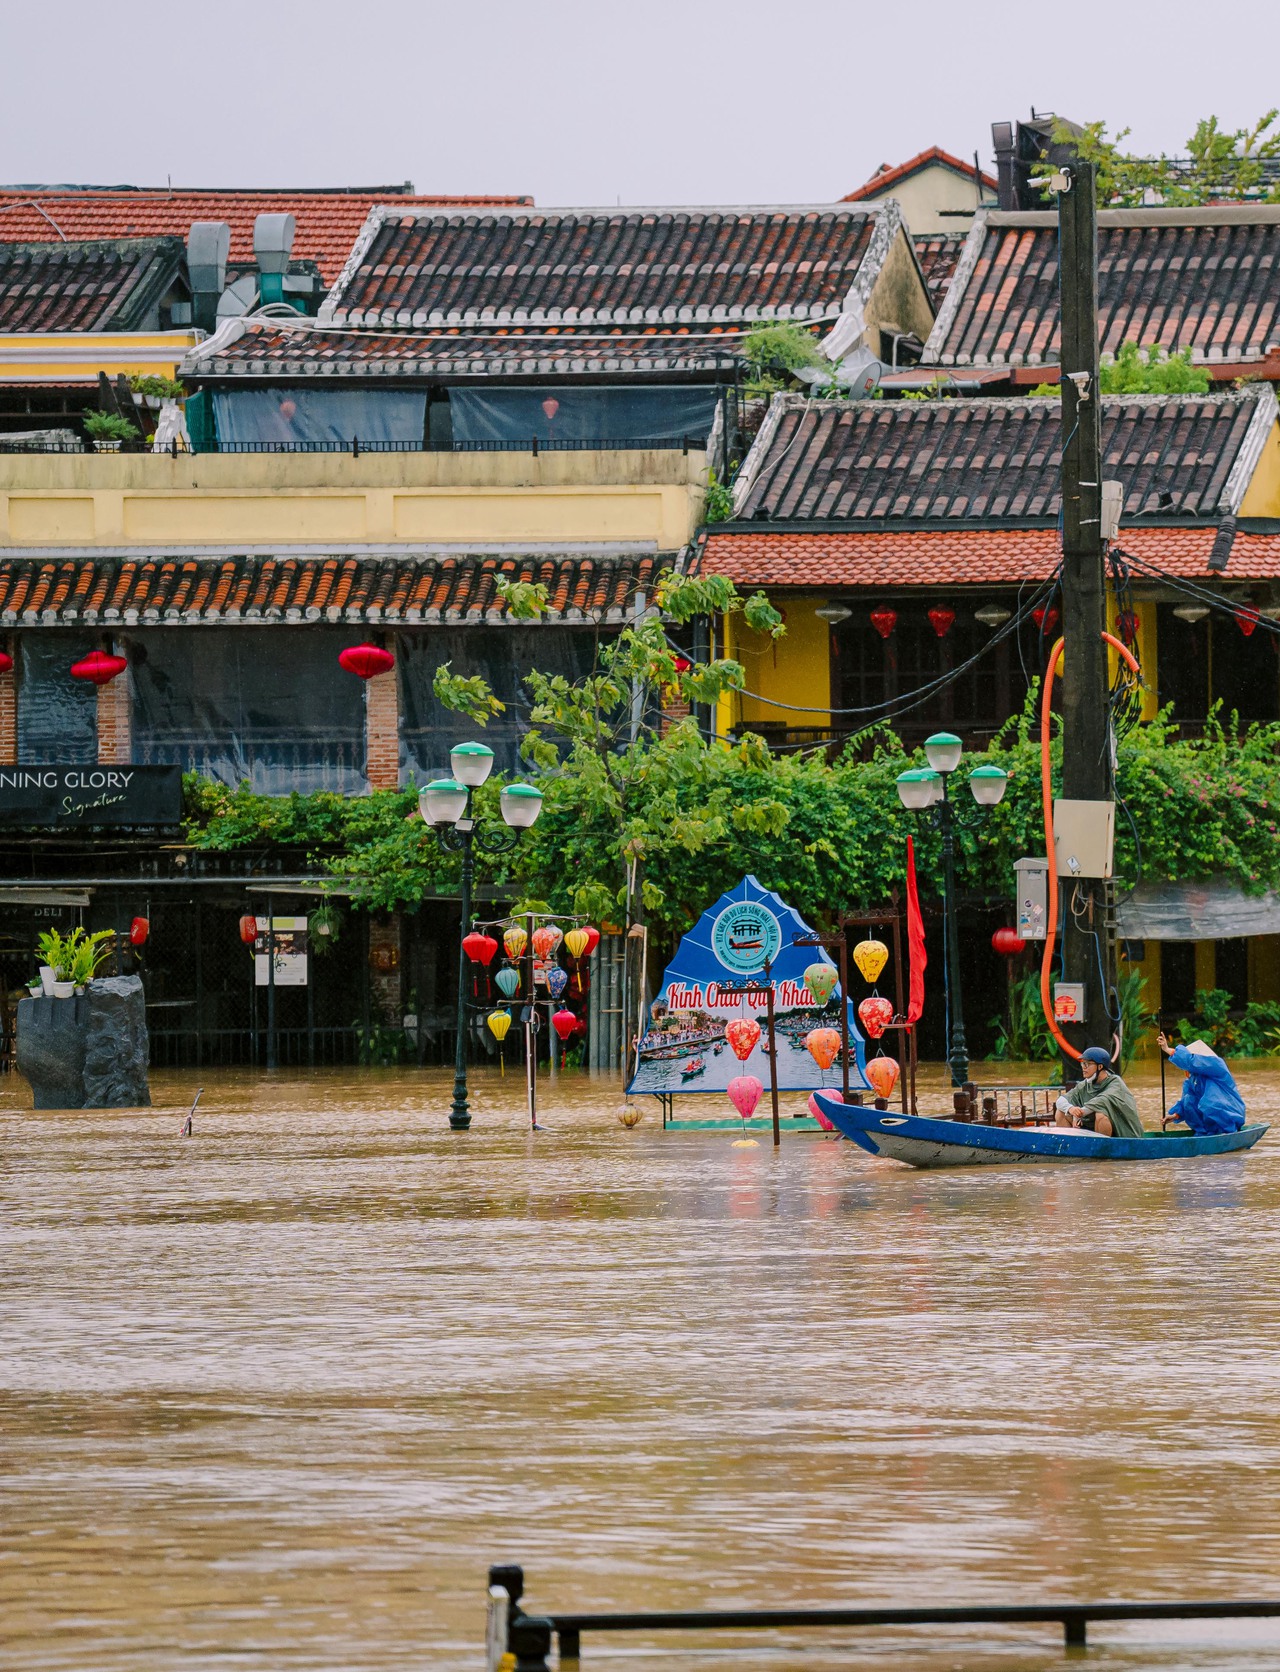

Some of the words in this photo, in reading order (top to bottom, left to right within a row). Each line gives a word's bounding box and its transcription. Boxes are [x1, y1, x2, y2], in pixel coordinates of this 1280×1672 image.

[0, 772, 58, 788] NING
[64, 771, 134, 788] GLORY
[58, 792, 127, 817] Signature
[34, 907, 63, 917] DELI
[668, 983, 703, 1008] Kính
